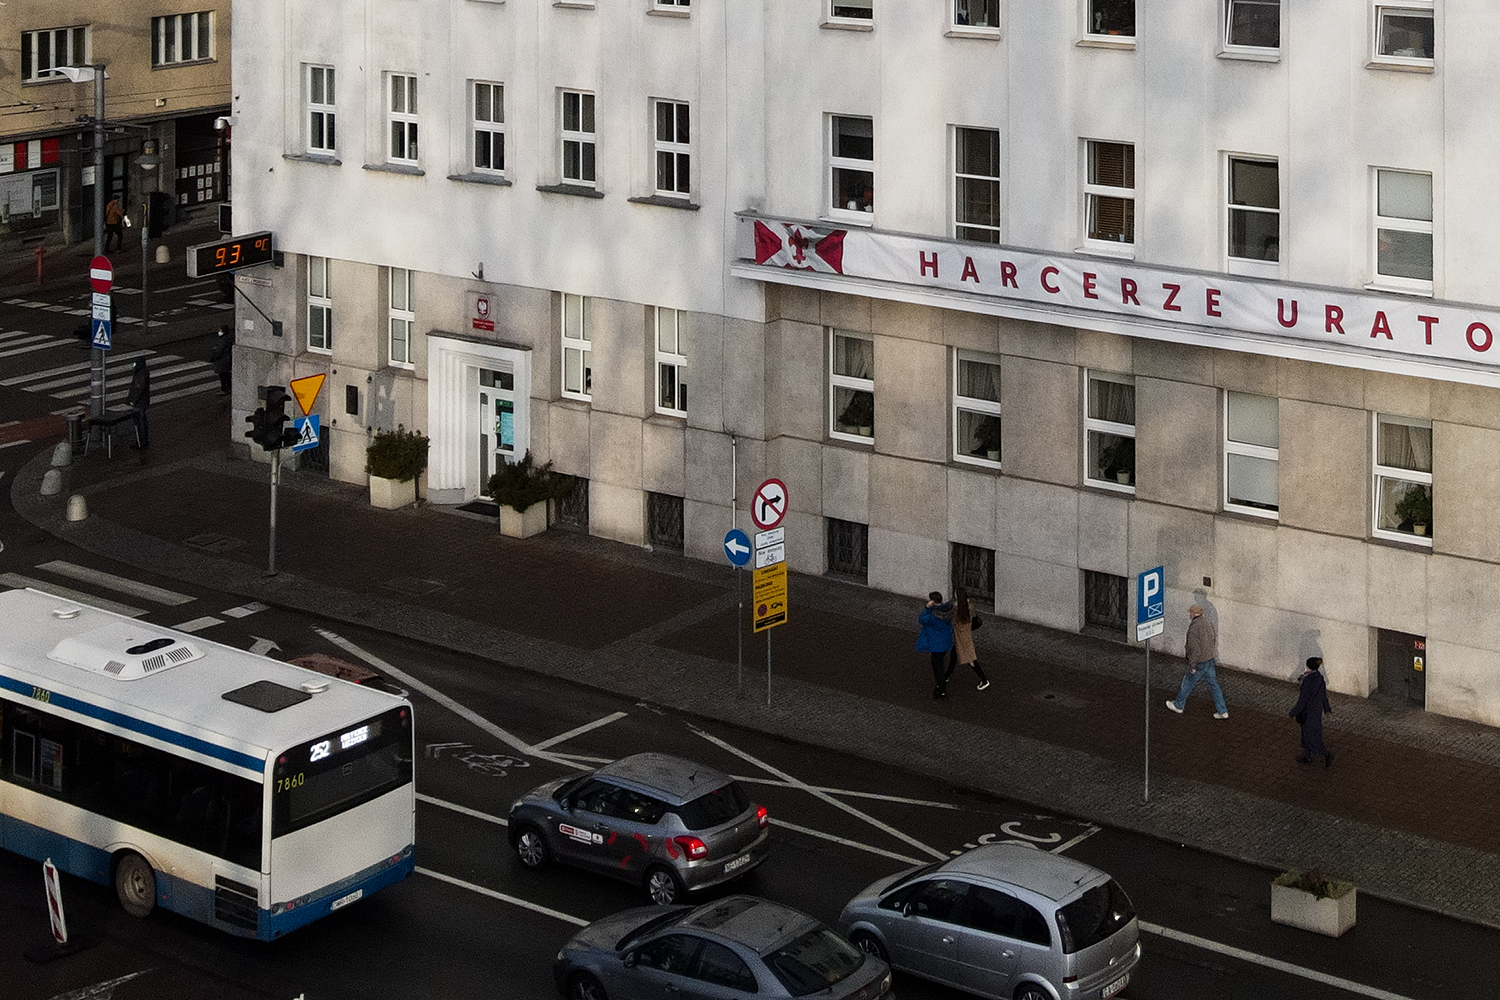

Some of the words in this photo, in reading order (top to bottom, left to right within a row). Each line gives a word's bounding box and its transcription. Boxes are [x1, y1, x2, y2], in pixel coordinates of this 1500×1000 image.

[919, 249, 1223, 318] HARCERZE
[1143, 572, 1160, 608] P
[310, 740, 330, 762] 252
[277, 772, 305, 794] 7860
